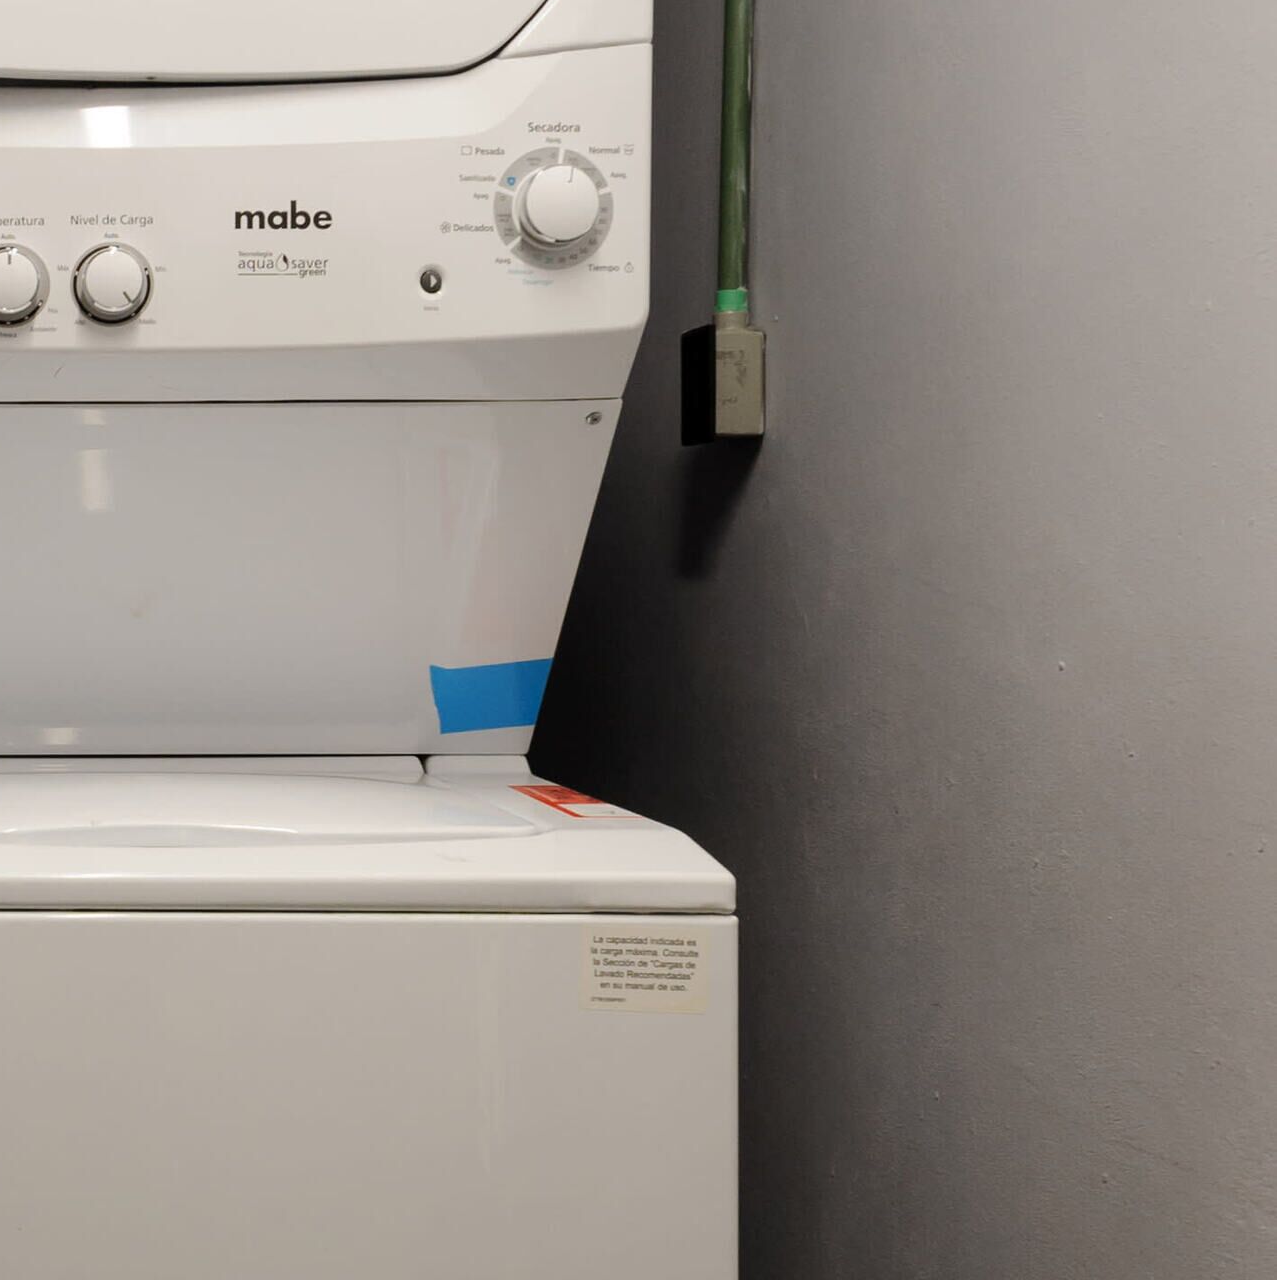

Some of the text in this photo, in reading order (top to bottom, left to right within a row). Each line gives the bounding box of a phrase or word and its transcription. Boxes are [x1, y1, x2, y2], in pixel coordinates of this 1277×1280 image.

[527, 121, 582, 133] Secadora
[474, 146, 506, 156] Pesada
[588, 145, 622, 154] Normal
[233, 200, 334, 230] mabe
[70, 214, 155, 229] Nivel de Carga
[453, 223, 495, 233] Delicados
[237, 257, 330, 272] aqua saver
[588, 263, 621, 273] Tiempo
[298, 269, 327, 280] green
[593, 936, 697, 947] La capacidad indicada es
[591, 946, 598, 954] la
[600, 948, 624, 957] carga
[593, 958, 601, 966] la
[602, 957, 636, 967] Sección
[637, 959, 648, 968] de
[685, 960, 697, 969] de
[594, 968, 625, 978] Lavado
[625, 982, 655, 990] manual
[657, 983, 668, 991] de
